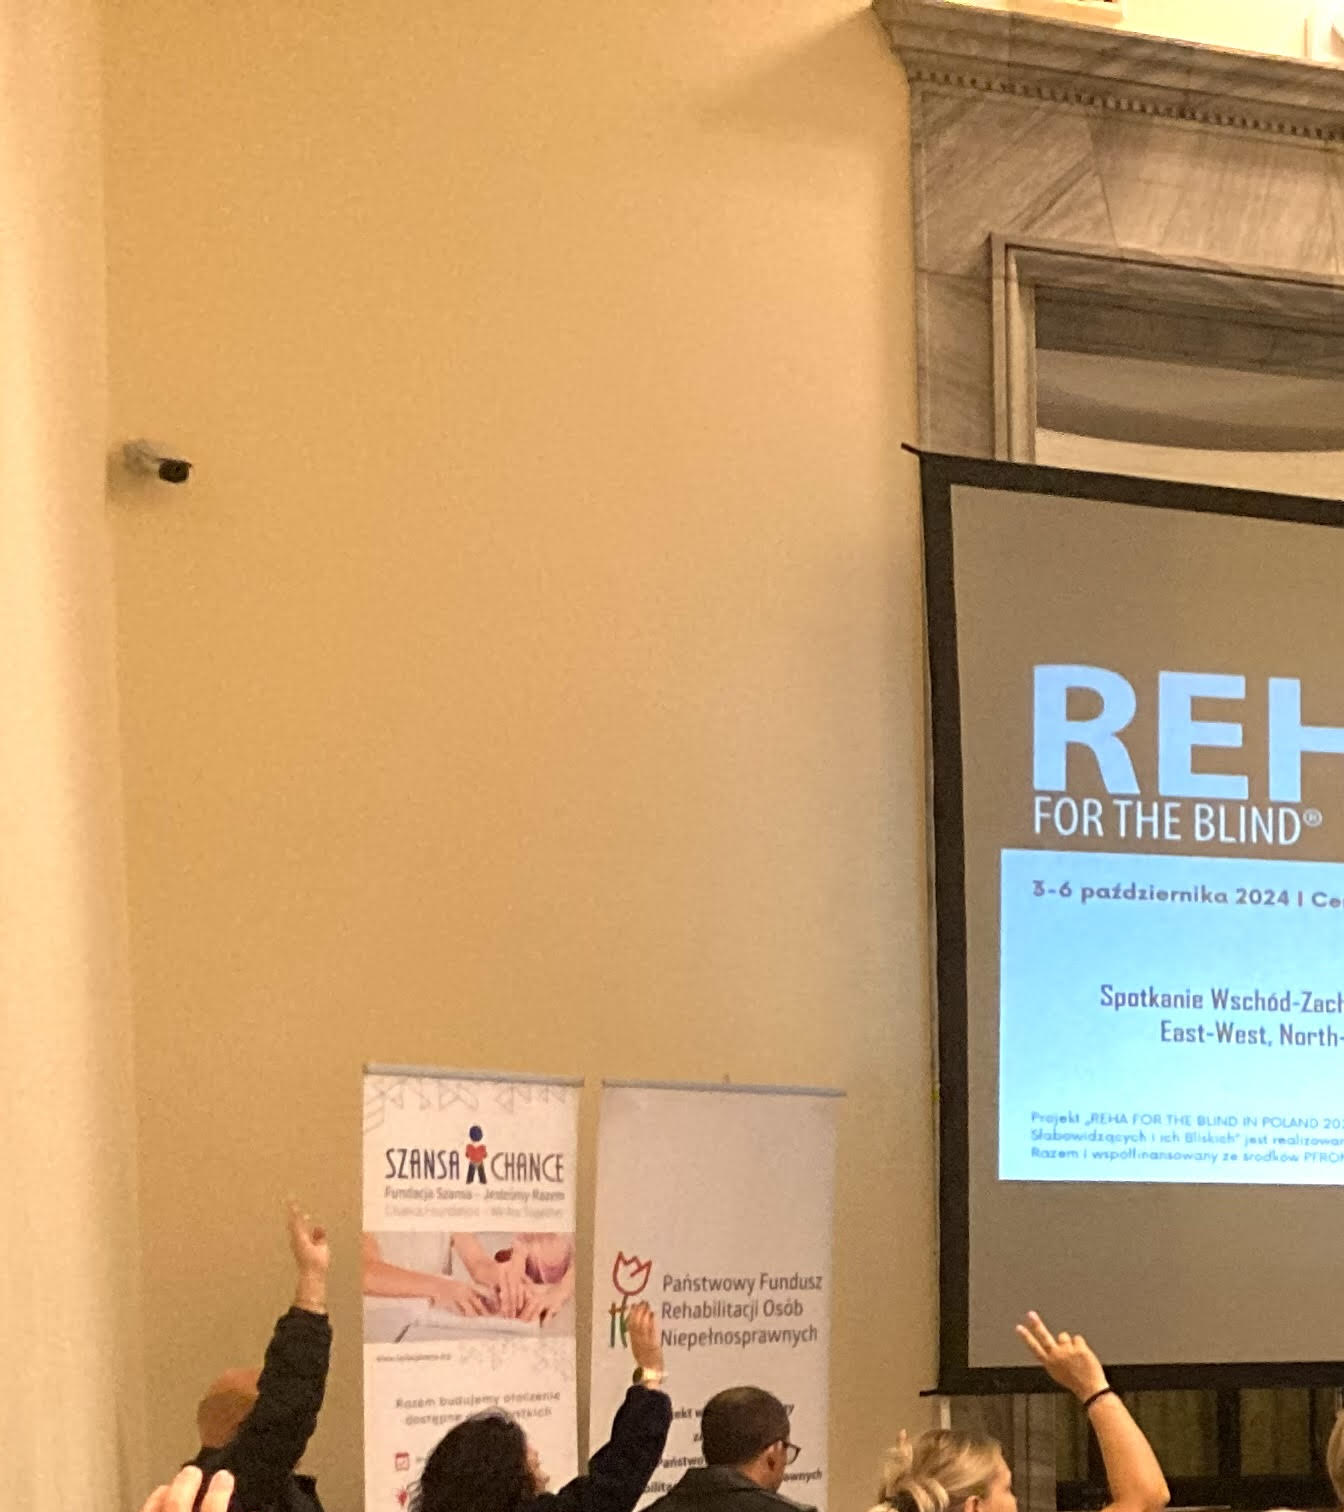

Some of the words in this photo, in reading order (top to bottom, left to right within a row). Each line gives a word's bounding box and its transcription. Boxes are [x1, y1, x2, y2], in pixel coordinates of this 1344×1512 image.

[1034, 796, 1103, 836] FOR
[1113, 799, 1182, 840] THE
[1033, 880, 1072, 898] 3-6
[1081, 882, 1228, 905] października
[1236, 888, 1290, 906] 2024
[1100, 984, 1203, 1011] Spotkanie
[1161, 1019, 1273, 1047] East-West,
[1031, 1111, 1079, 1126] Projekt
[1133, 1113, 1161, 1125] FOR
[1167, 1114, 1192, 1126] THE
[1197, 1115, 1238, 1127] BLIND
[1243, 1115, 1258, 1128] IN
[1262, 1116, 1318, 1129] POLAND
[1031, 1128, 1146, 1145] Słabowidzących
[1244, 1134, 1268, 1147] jest
[385, 1148, 460, 1180] SZANSA
[490, 1152, 564, 1182] CHANCE
[1031, 1147, 1078, 1159] Razem
[1222, 1152, 1237, 1161] ze
[663, 1275, 755, 1295] Państwowy
[759, 1273, 823, 1290] Fundusz
[662, 1299, 758, 1321] Rehabilitacji
[763, 1299, 803, 1318] Osób
[661, 1324, 817, 1351] Niepełnosprawnych
[396, 1396, 435, 1409] Razem
[439, 1394, 499, 1407] budujemy
[504, 1391, 561, 1404] otoczenie
